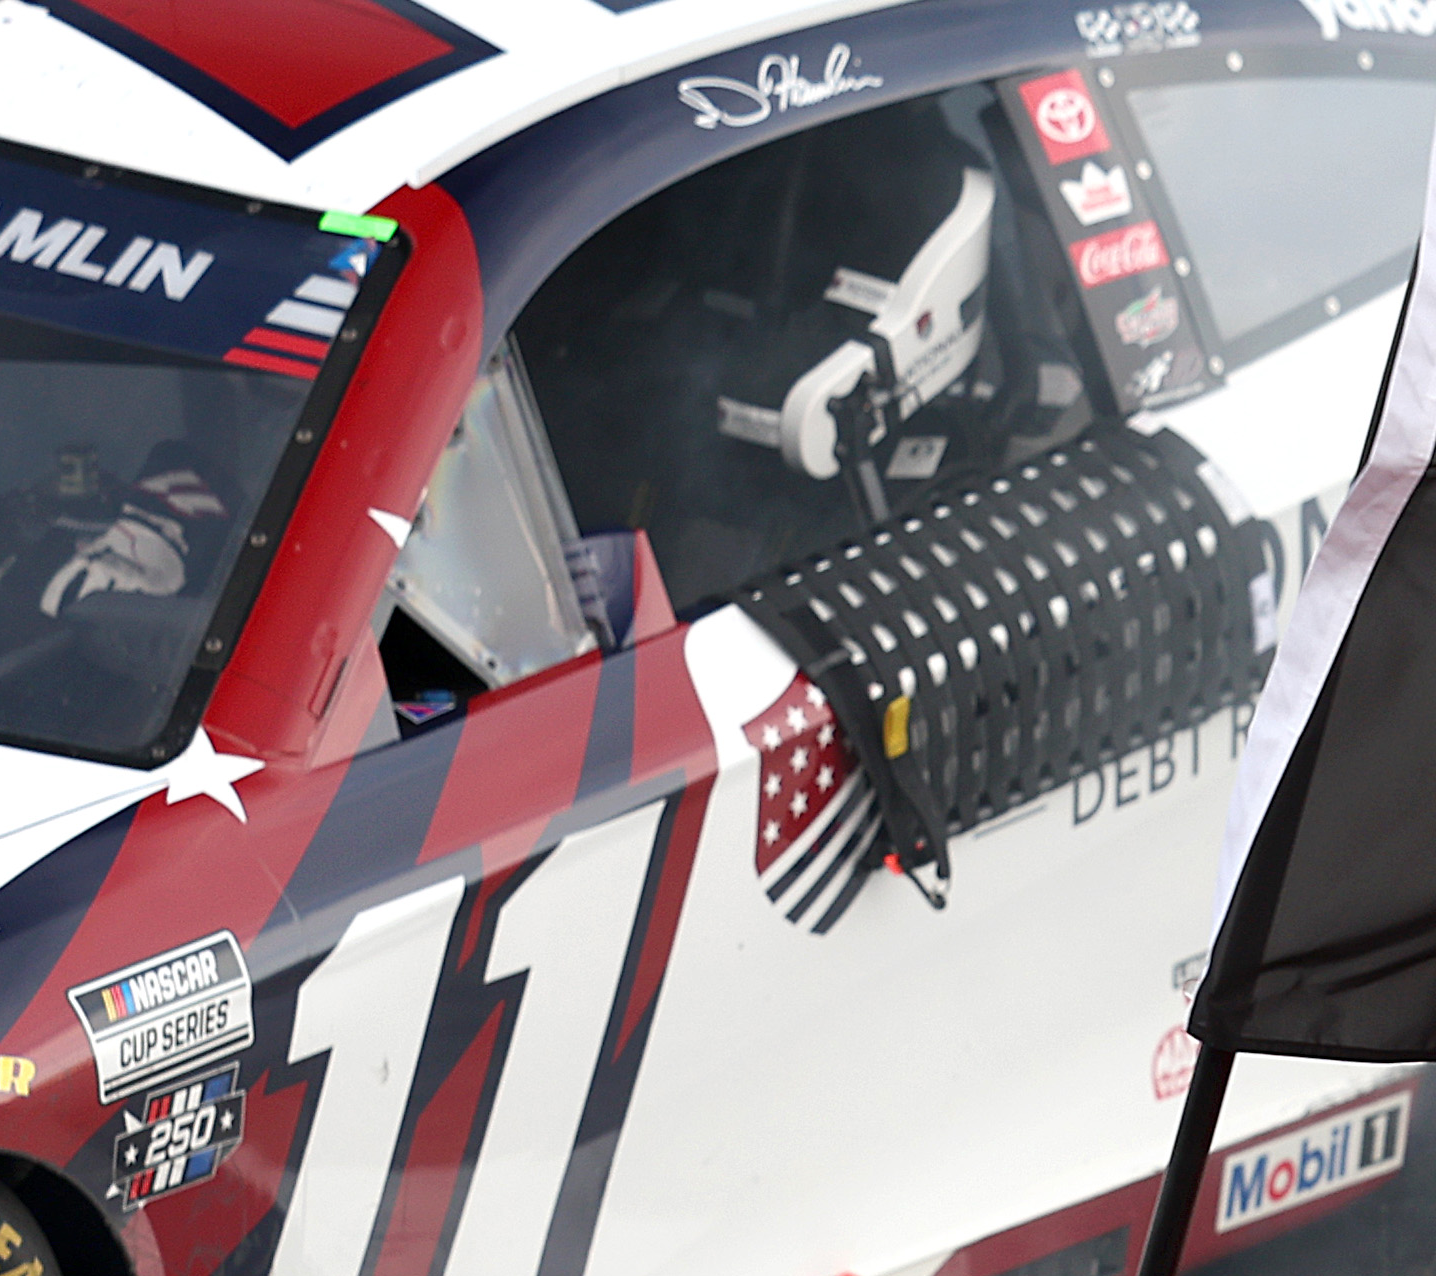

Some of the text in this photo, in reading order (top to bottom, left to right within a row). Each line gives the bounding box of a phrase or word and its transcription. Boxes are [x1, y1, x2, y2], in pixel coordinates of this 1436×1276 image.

[128, 951, 220, 1016] NASCAR
[119, 1000, 230, 1068] CUP SERIES
[144, 1107, 216, 1167] 250
[1226, 1121, 1352, 1222] Mobil
